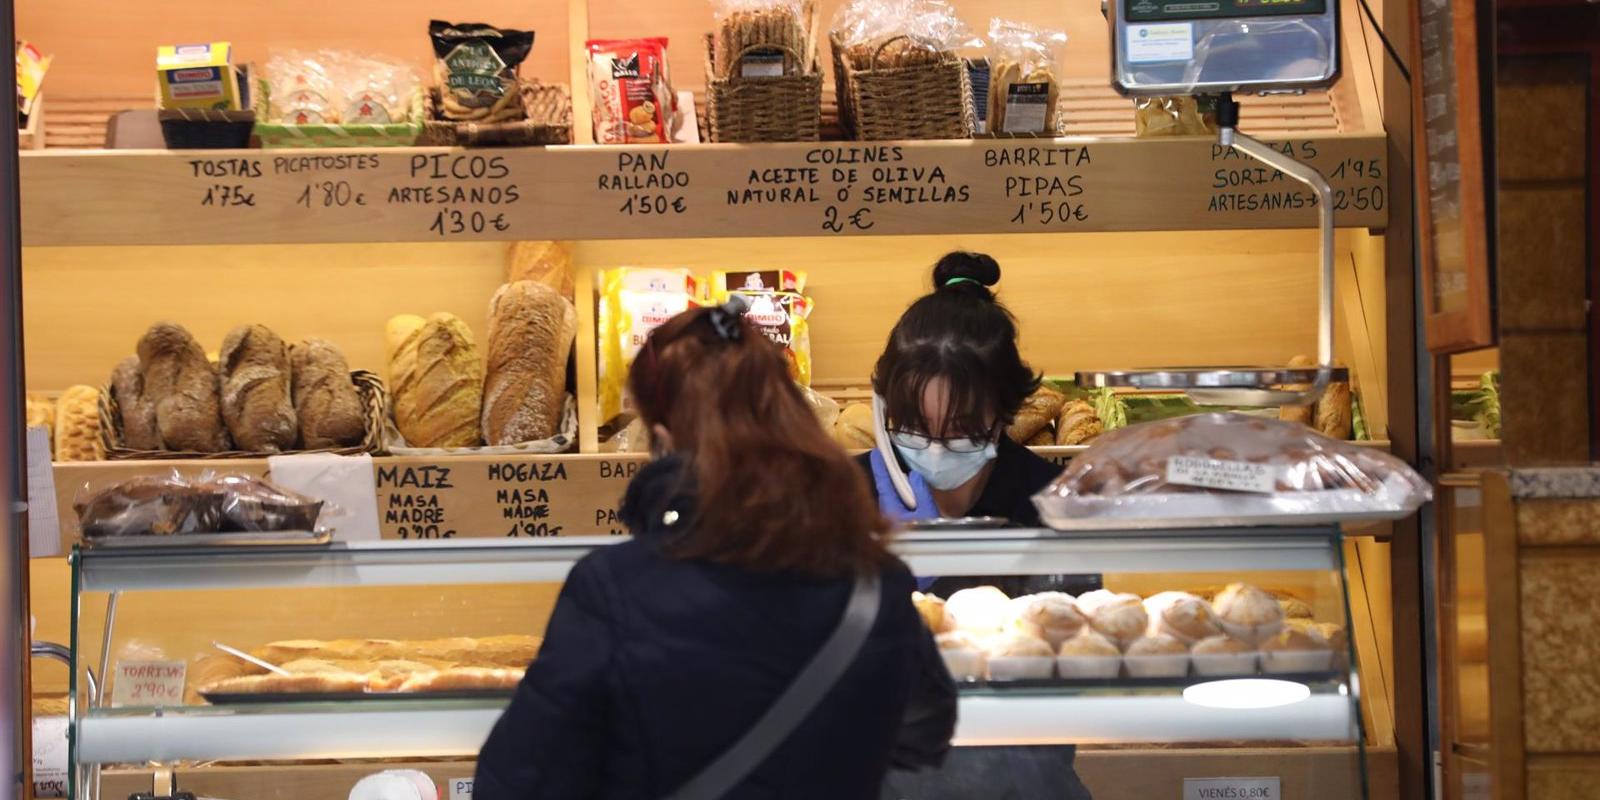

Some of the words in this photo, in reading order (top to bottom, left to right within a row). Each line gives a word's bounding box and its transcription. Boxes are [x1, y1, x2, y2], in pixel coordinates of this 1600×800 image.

[273, 153, 380, 174] PICATOSTES
[618, 150, 670, 172] PAN
[806, 146, 904, 164] COLINES
[984, 146, 1091, 167] BARRITA
[190, 158, 262, 178] TOSTAS
[410, 153, 510, 179] PICOS
[748, 168, 819, 185] ACEITE
[832, 168, 858, 183] DE
[872, 166, 946, 183] OLIVA
[1212, 167, 1285, 189] SORIA
[1330, 158, 1382, 180] 1'95
[598, 171, 689, 190] RALLADO
[1005, 175, 1083, 197] PIPAS
[297, 180, 367, 208] 1'80€
[388, 184, 520, 204] ARTESANOS
[727, 188, 820, 205] NATURAL
[863, 185, 970, 204] SEMILLAS
[1208, 191, 1305, 212] ARTESANAS
[1333, 185, 1383, 212] 2'50
[619, 194, 687, 216] 1'50€
[429, 207, 510, 235] 1'30€
[377, 465, 453, 489] MAIZ
[488, 462, 567, 482] HOGAZA
[389, 494, 438, 508] MASA
[497, 489, 549, 504] MASA
[385, 508, 445, 524] MADRE
[596, 508, 618, 526] PA
[456, 781, 474, 794] PI
[1199, 786, 1237, 798] VIENÉS
[1240, 787, 1271, 799] 0,80€
